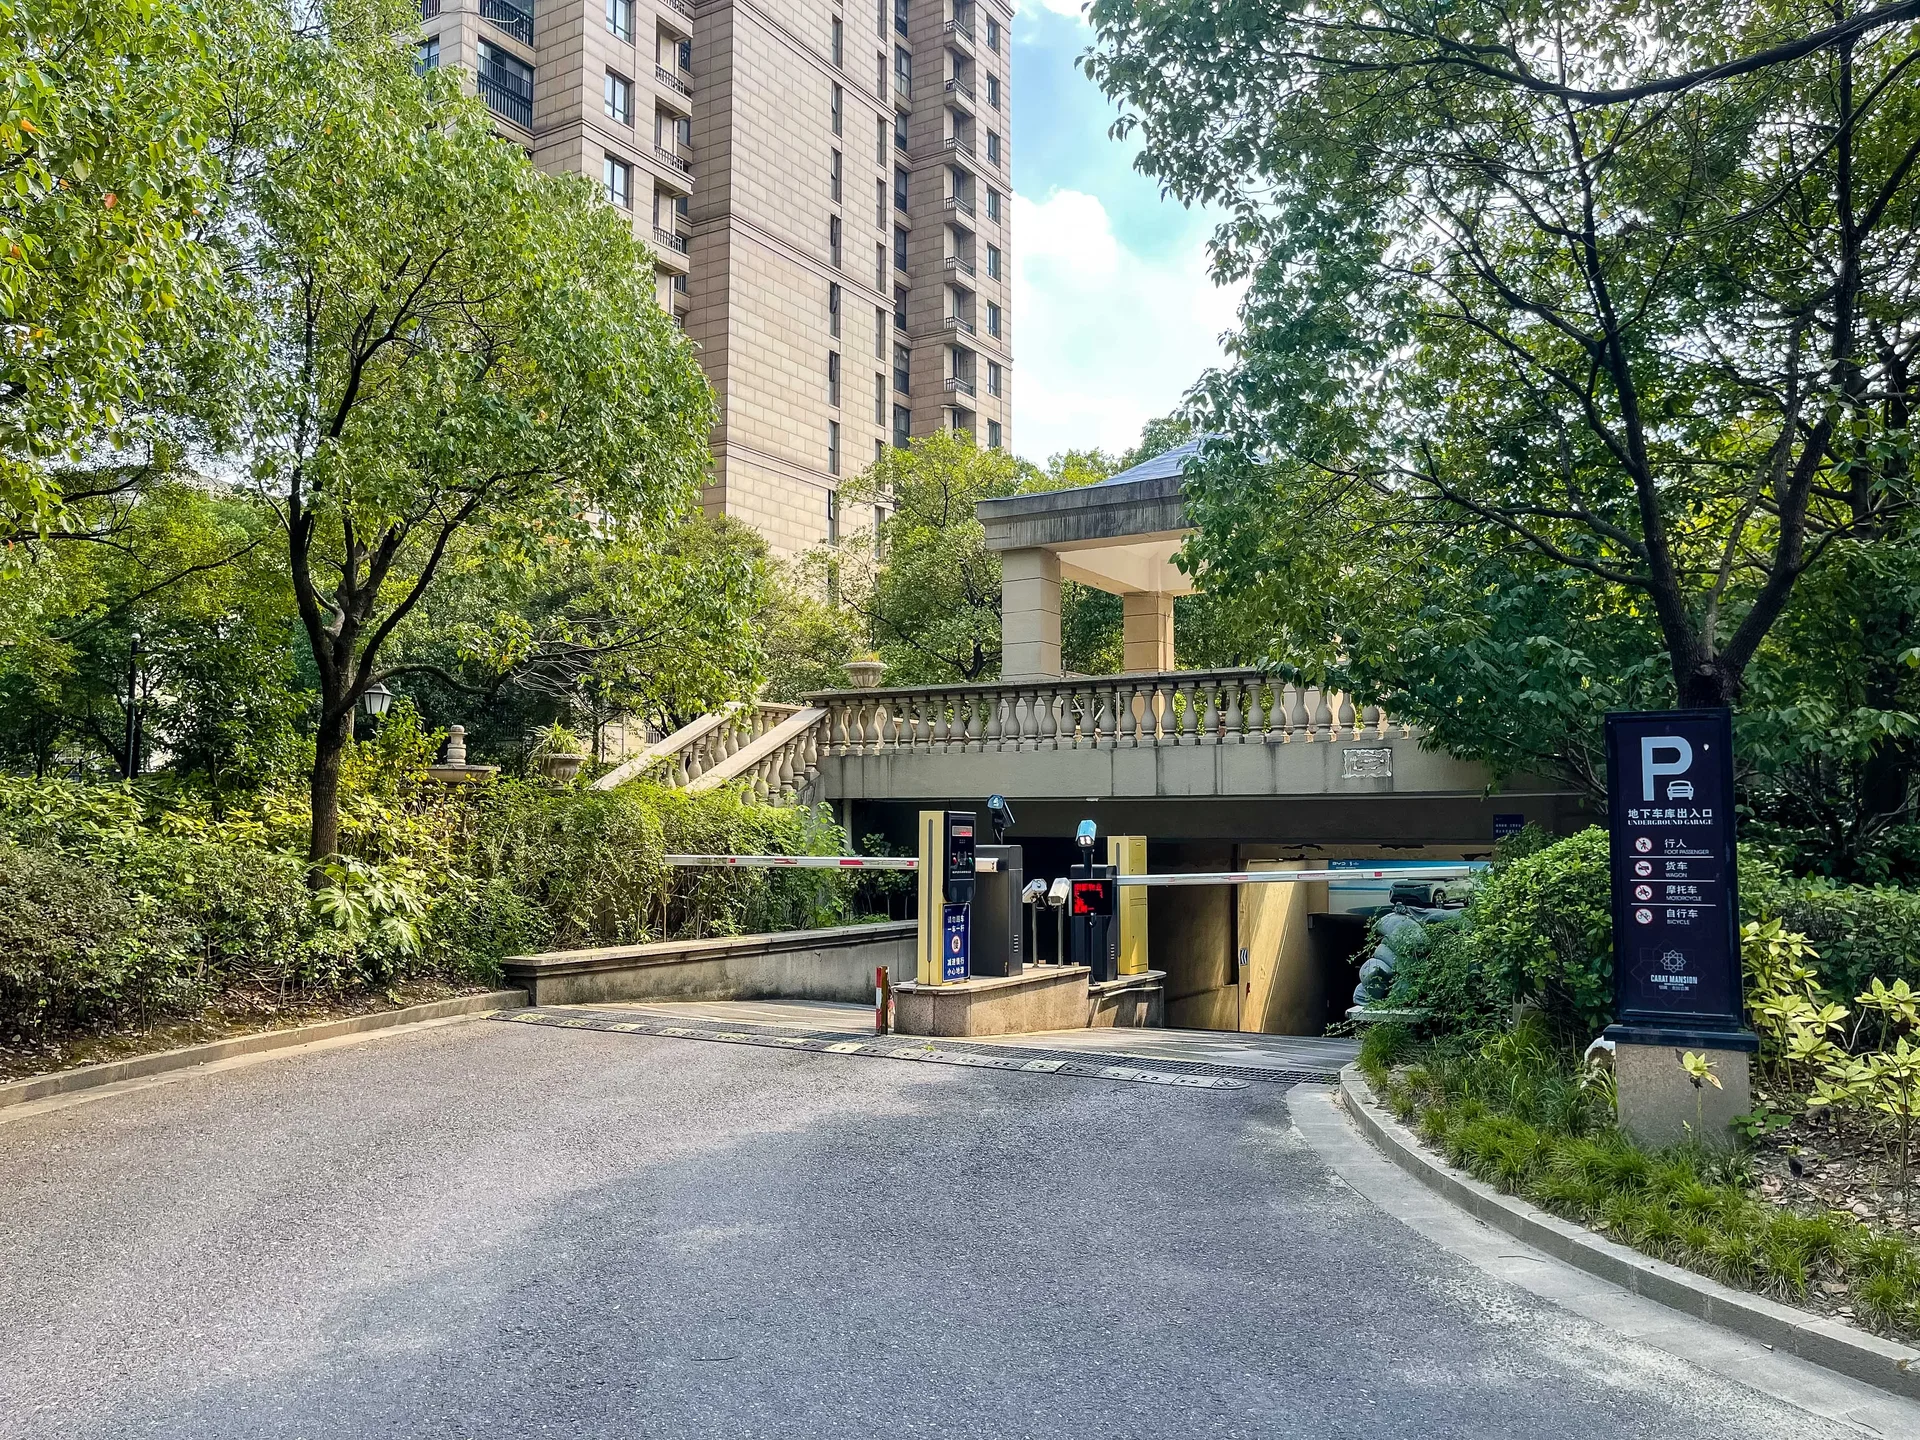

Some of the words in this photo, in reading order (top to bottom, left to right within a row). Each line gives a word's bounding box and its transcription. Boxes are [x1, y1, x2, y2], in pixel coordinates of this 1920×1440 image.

[1641, 736, 1693, 801] P
[1628, 808, 1712, 819] 地下车库出入口
[1664, 838, 1687, 848] 行人
[1665, 861, 1688, 871] 货车
[1666, 885, 1698, 894] 摩托车
[1666, 909, 1698, 918] 自行车
[1650, 974, 1669, 983] CARAT
[1669, 975, 1698, 984] MANSION
